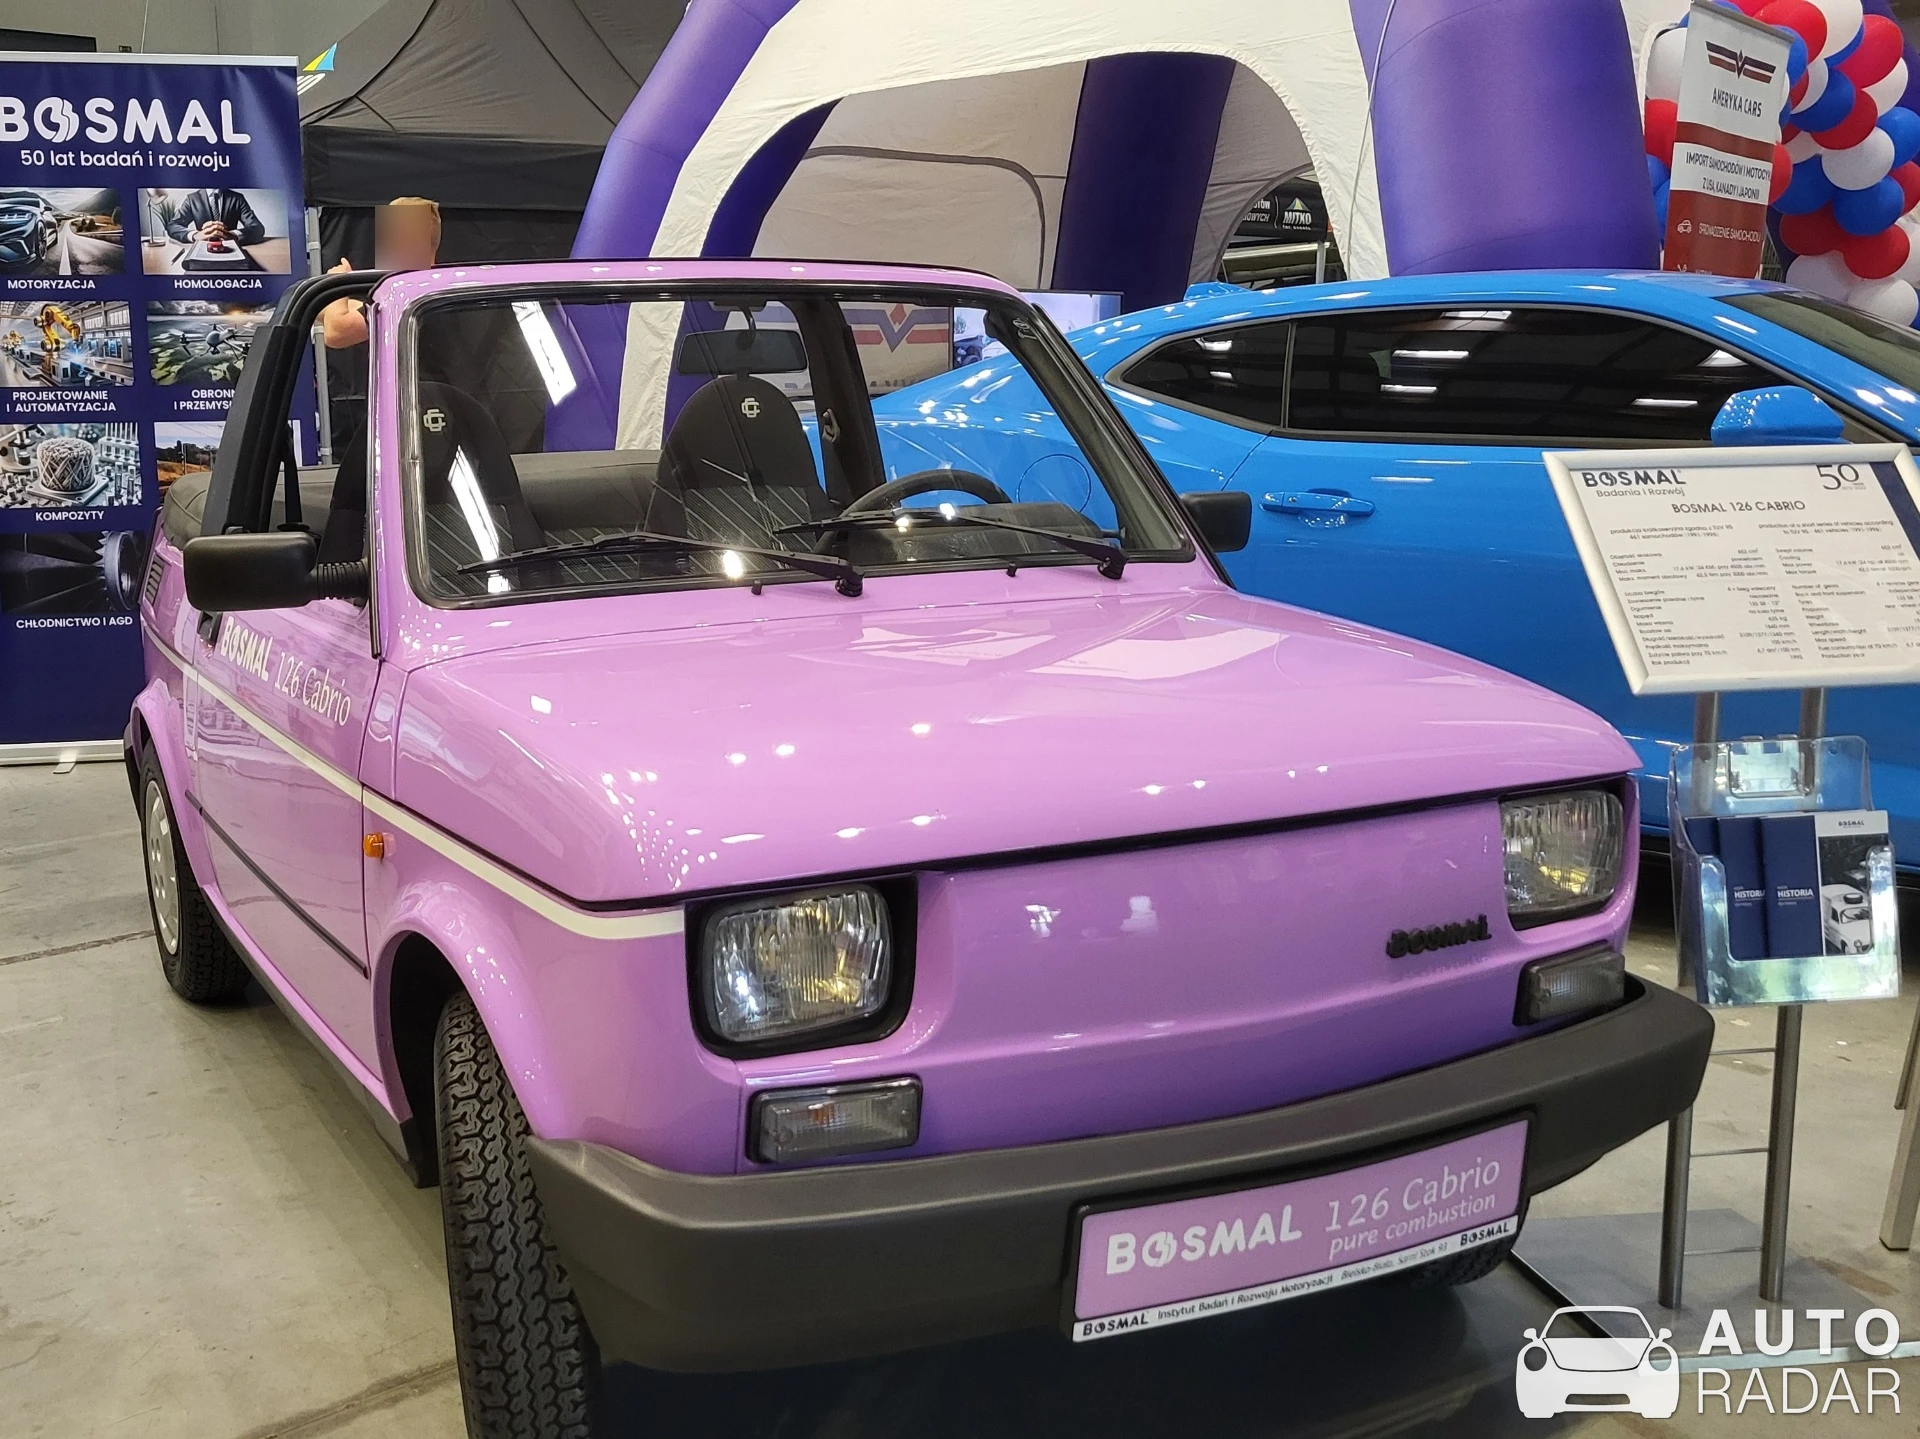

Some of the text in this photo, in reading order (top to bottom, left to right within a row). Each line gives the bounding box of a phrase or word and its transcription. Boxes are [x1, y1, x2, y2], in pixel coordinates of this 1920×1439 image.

[1712, 88, 1762, 118] AMERYKA CARS
[0, 96, 251, 144] BOSMAL
[20, 150, 230, 172] 50 lat badań i rozwoju
[1686, 152, 1709, 168] IMPORT
[1716, 181, 1736, 197] KANADY
[1282, 211, 1312, 225] MITKO
[7, 279, 96, 290] MOTORYZACJA
[174, 278, 263, 290] HOMOLOGACJA
[12, 390, 109, 401] PROJEKTOWANIE
[6, 401, 117, 413] I AUTOMATYZACJA
[174, 400, 177, 410] I
[1581, 469, 1687, 488] BOSMAL
[1816, 463, 1860, 490] 50
[1596, 488, 1641, 498] Badania
[1648, 488, 1686, 497] Rozwój
[1672, 500, 1806, 514] BOSMAL 126 CABRIO
[35, 511, 105, 522] KOMPOZYTY
[16, 616, 134, 629] CHŁODNICTWO I AGD
[220, 616, 351, 726] BOSMAL 126 Cabrio
[1777, 888, 1814, 898] HISTORIA
[1325, 1156, 1500, 1232] 126 Cabrio
[1329, 1192, 1496, 1260] pure combustion
[1106, 1205, 1302, 1275] BOSMAL
[1082, 1314, 1149, 1336] BOSMAL
[1157, 1304, 1196, 1320] Instytut
[1198, 1297, 1228, 1312] Badań
[1236, 1288, 1278, 1306] Rozwoju
[1460, 1222, 1509, 1247] BOSMAL
